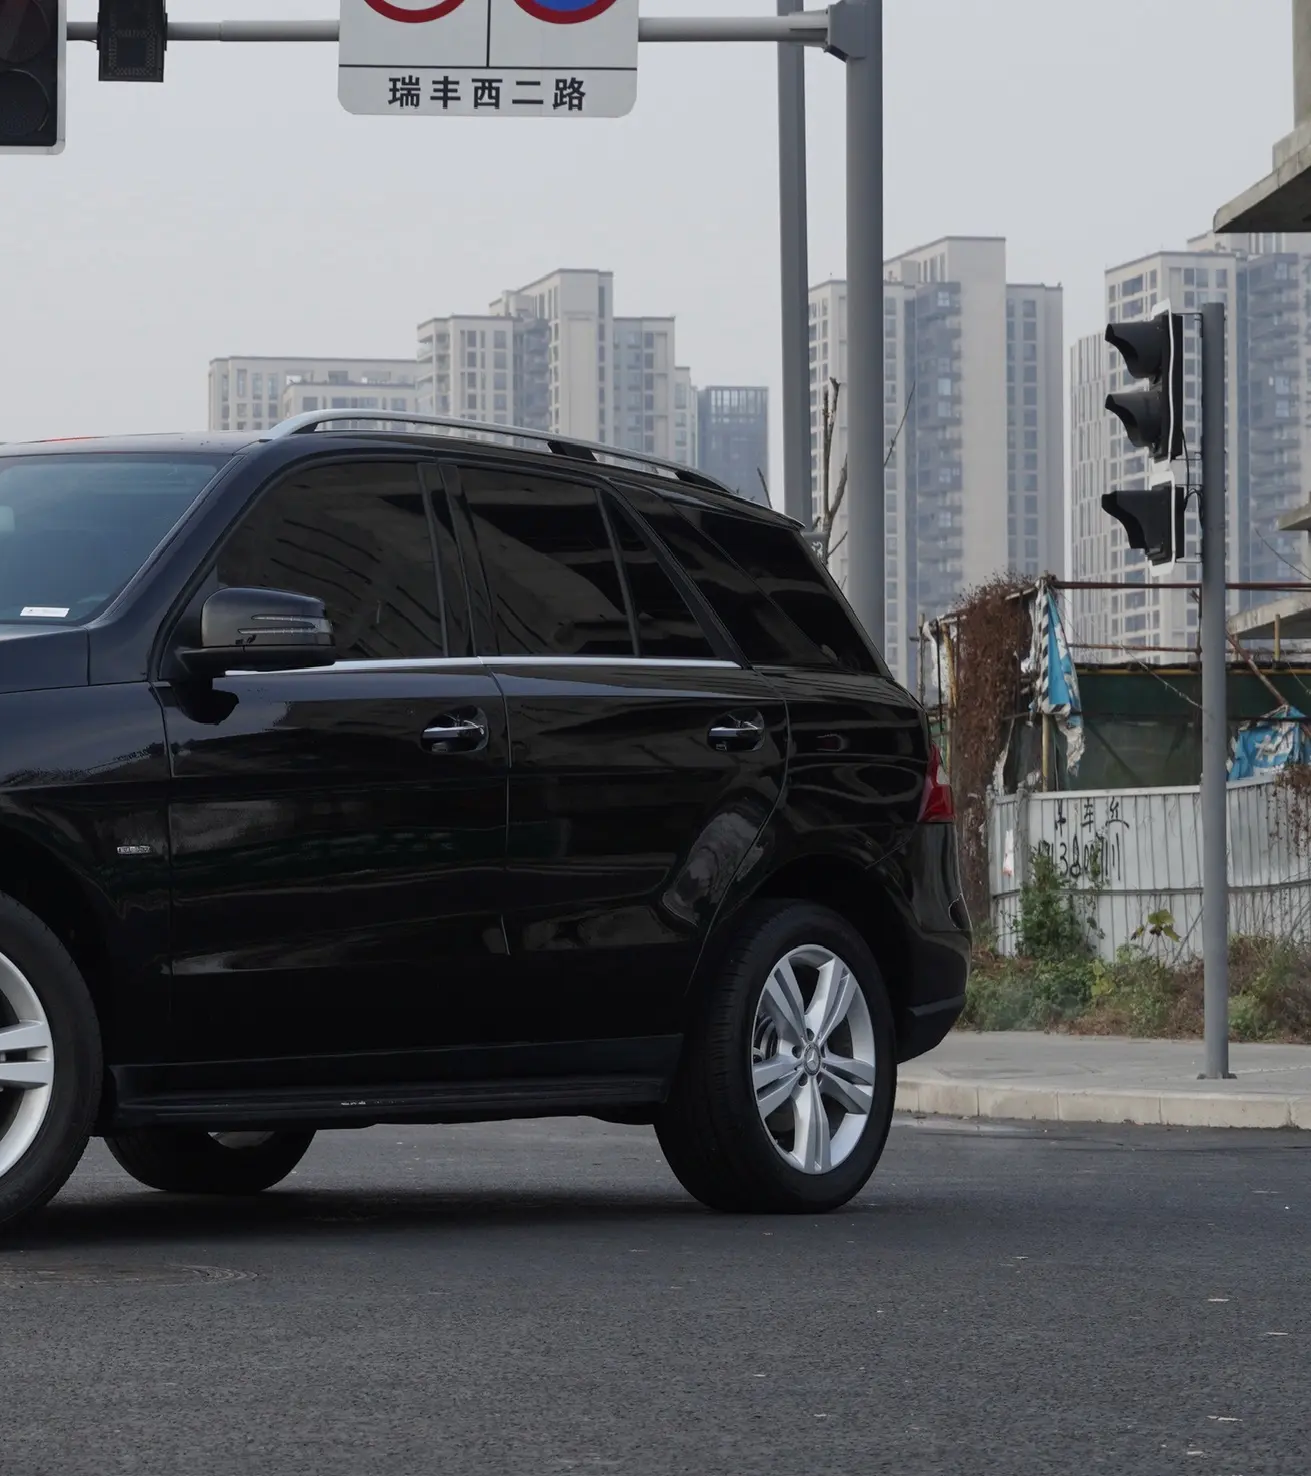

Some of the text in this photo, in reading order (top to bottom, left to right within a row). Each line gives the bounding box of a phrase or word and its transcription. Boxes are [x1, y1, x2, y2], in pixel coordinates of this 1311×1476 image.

[388, 75, 586, 111] 瑞丰西二路
